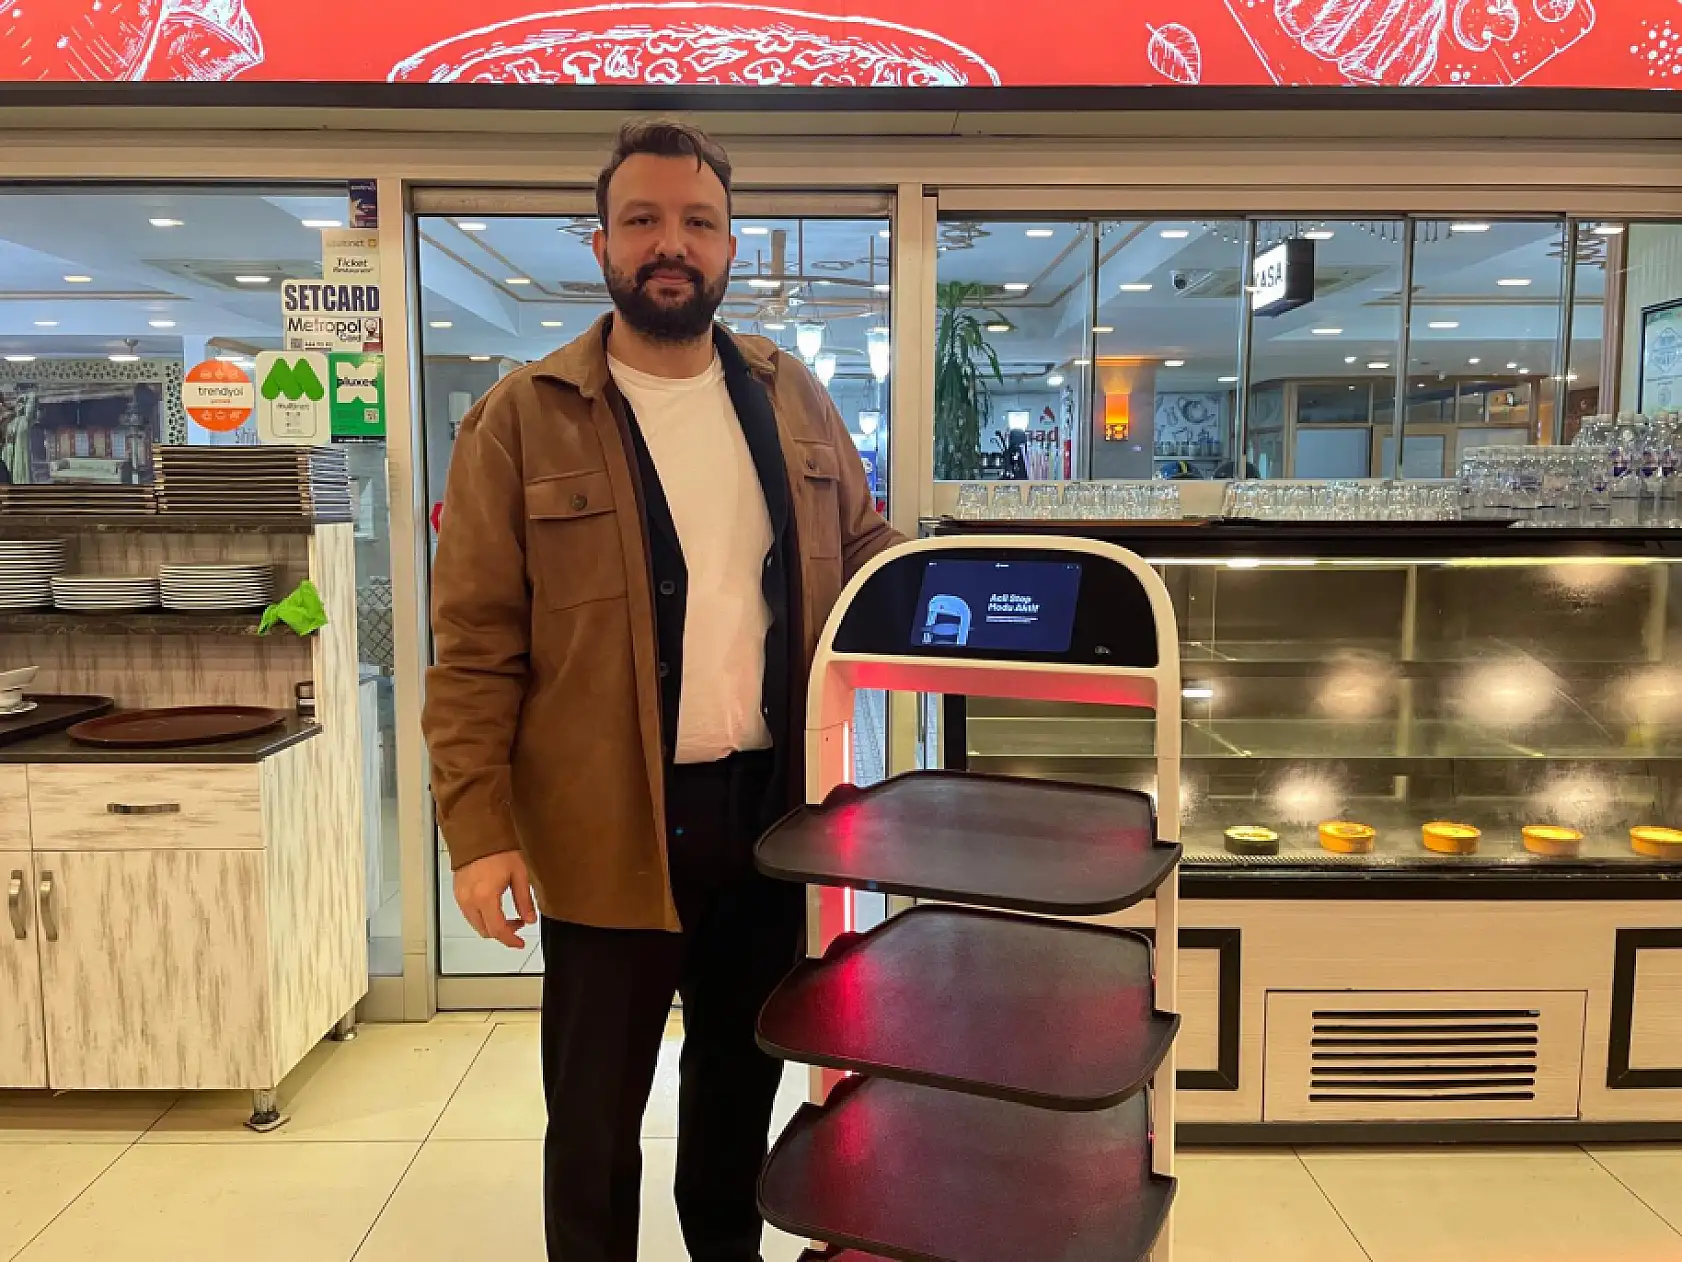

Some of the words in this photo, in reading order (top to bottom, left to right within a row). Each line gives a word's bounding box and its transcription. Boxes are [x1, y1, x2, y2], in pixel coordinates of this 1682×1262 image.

[337, 257, 368, 267] Ticket
[285, 285, 380, 311] SETCARD
[288, 318, 361, 335] Metropol
[198, 386, 243, 396] trendyol
[1010, 594, 1031, 604] Stop
[988, 603, 1014, 611] Modu
